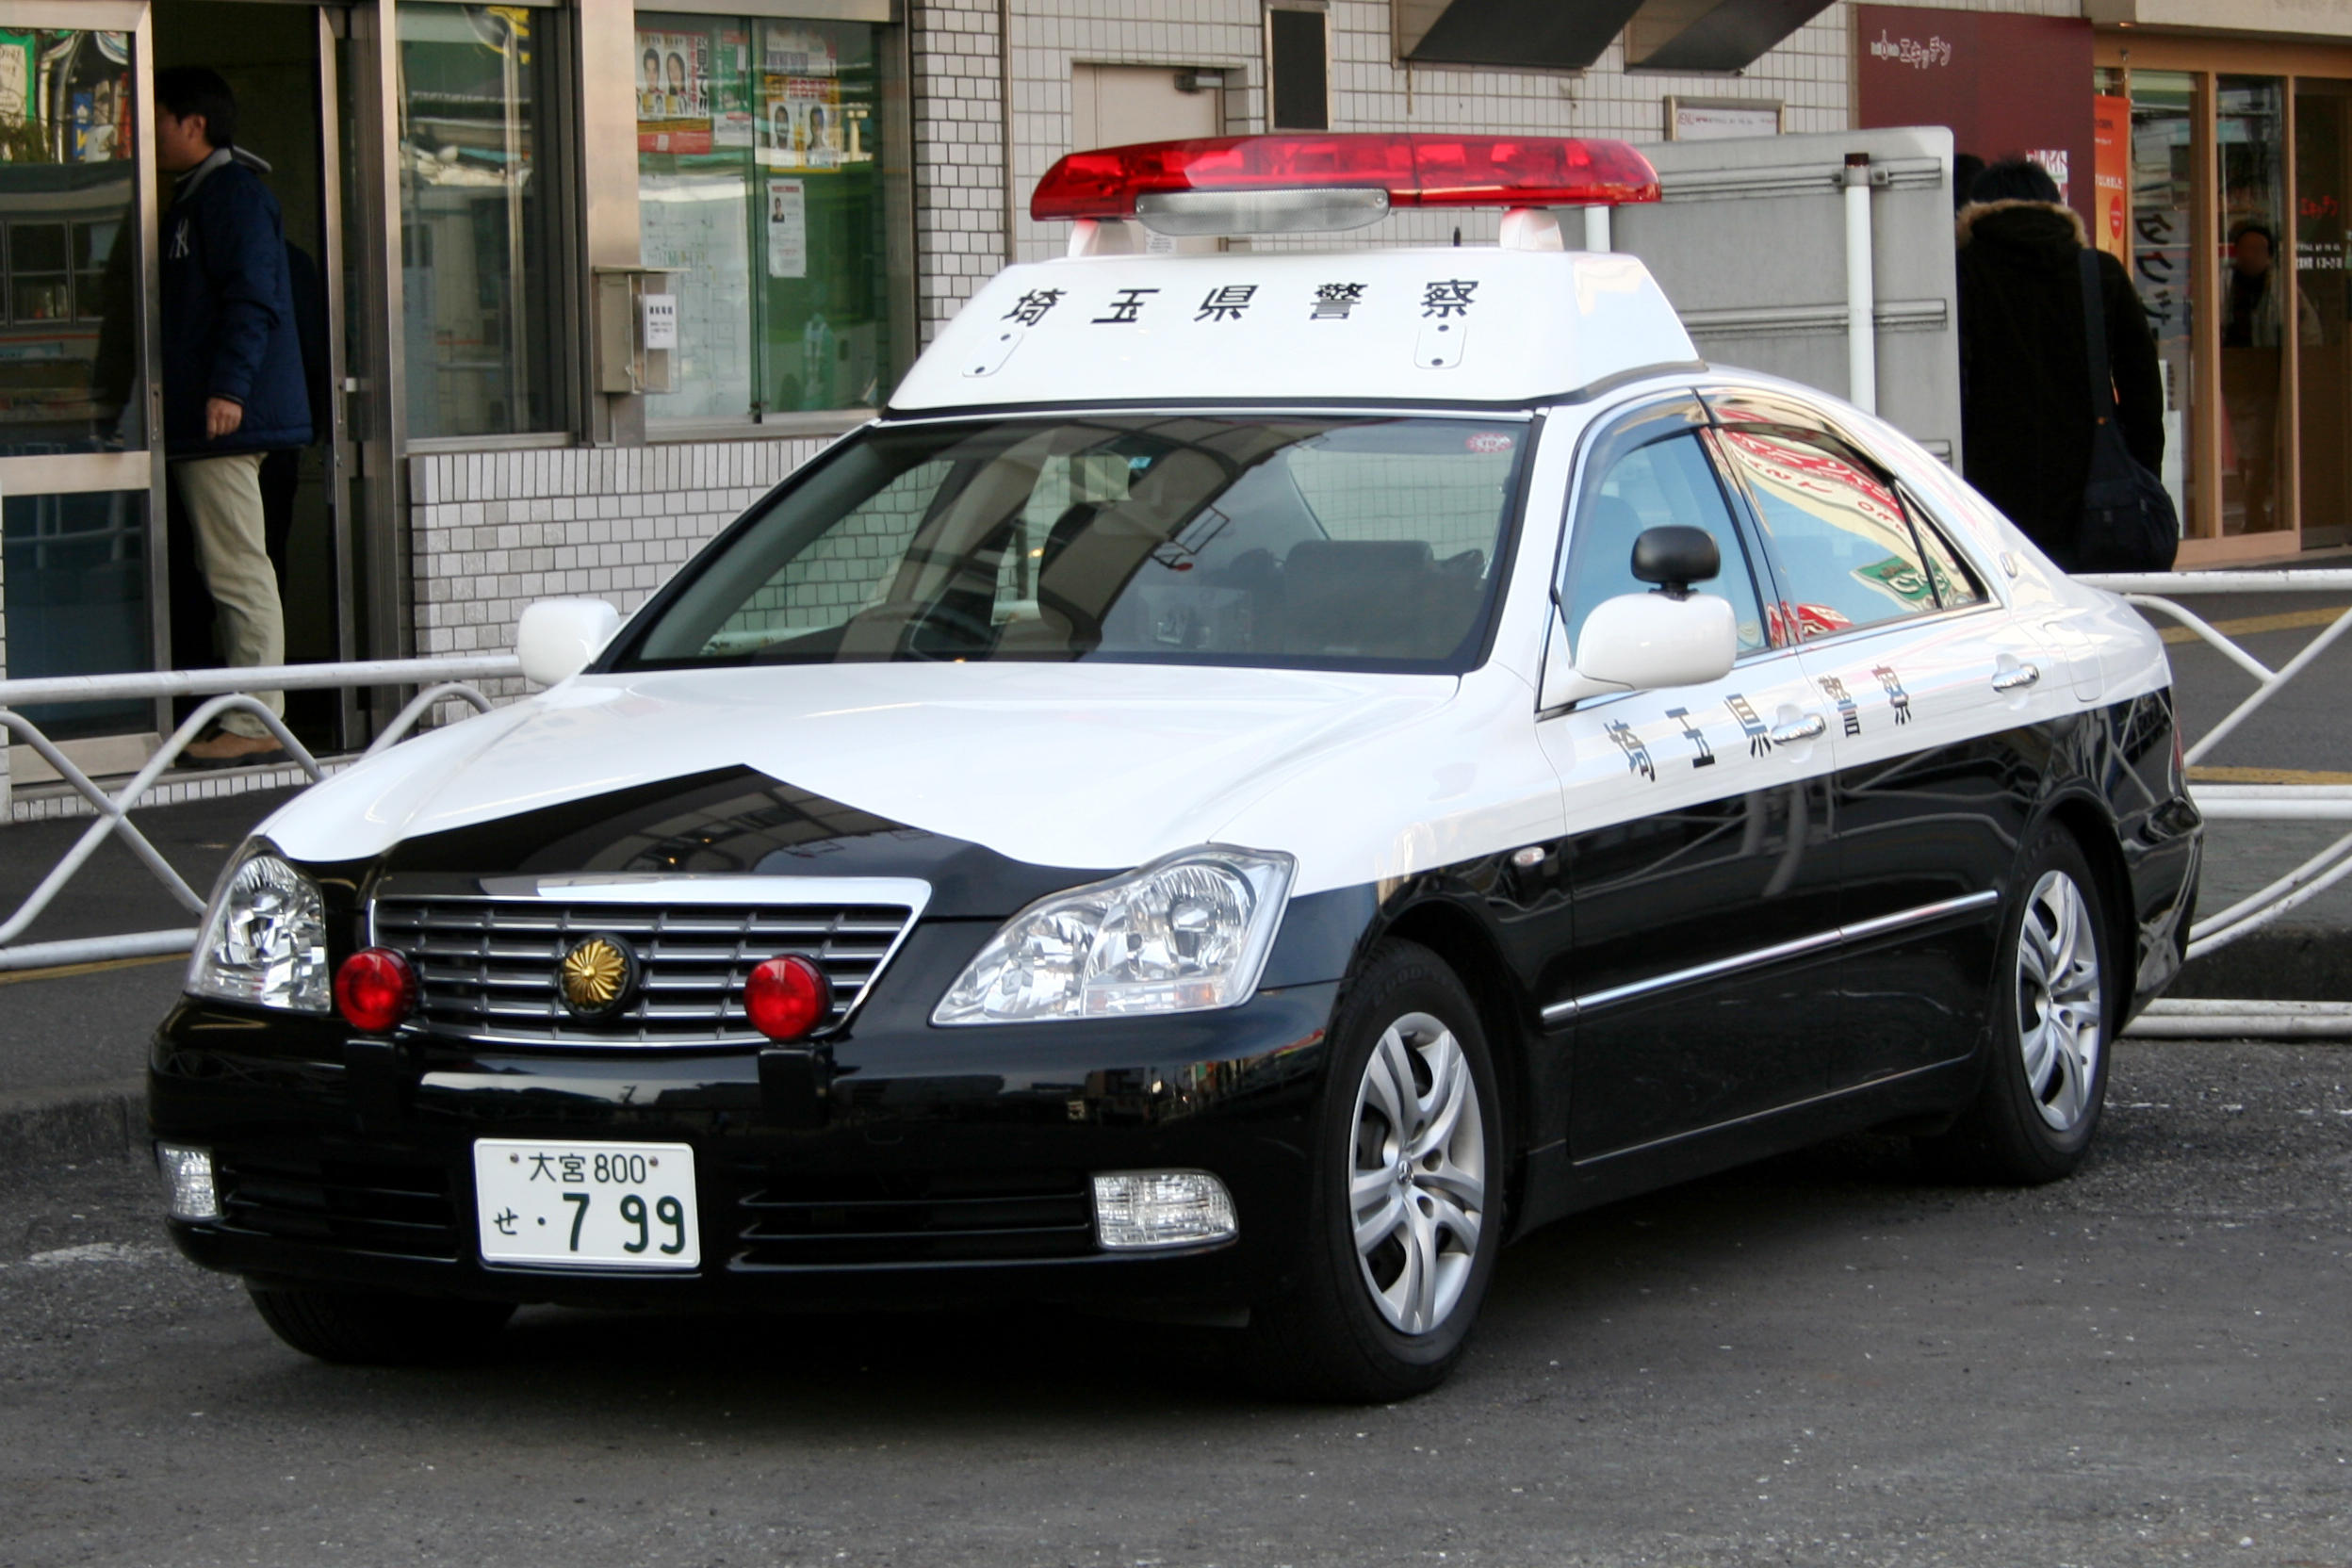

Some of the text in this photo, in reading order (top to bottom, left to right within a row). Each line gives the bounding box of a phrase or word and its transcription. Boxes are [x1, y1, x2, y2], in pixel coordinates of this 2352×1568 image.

[1001, 279, 1480, 327] 埼玉県警察
[1603, 663, 1912, 783] 埼玉県警察
[594, 1153, 647, 1184] 800
[493, 1206, 519, 1235] せ
